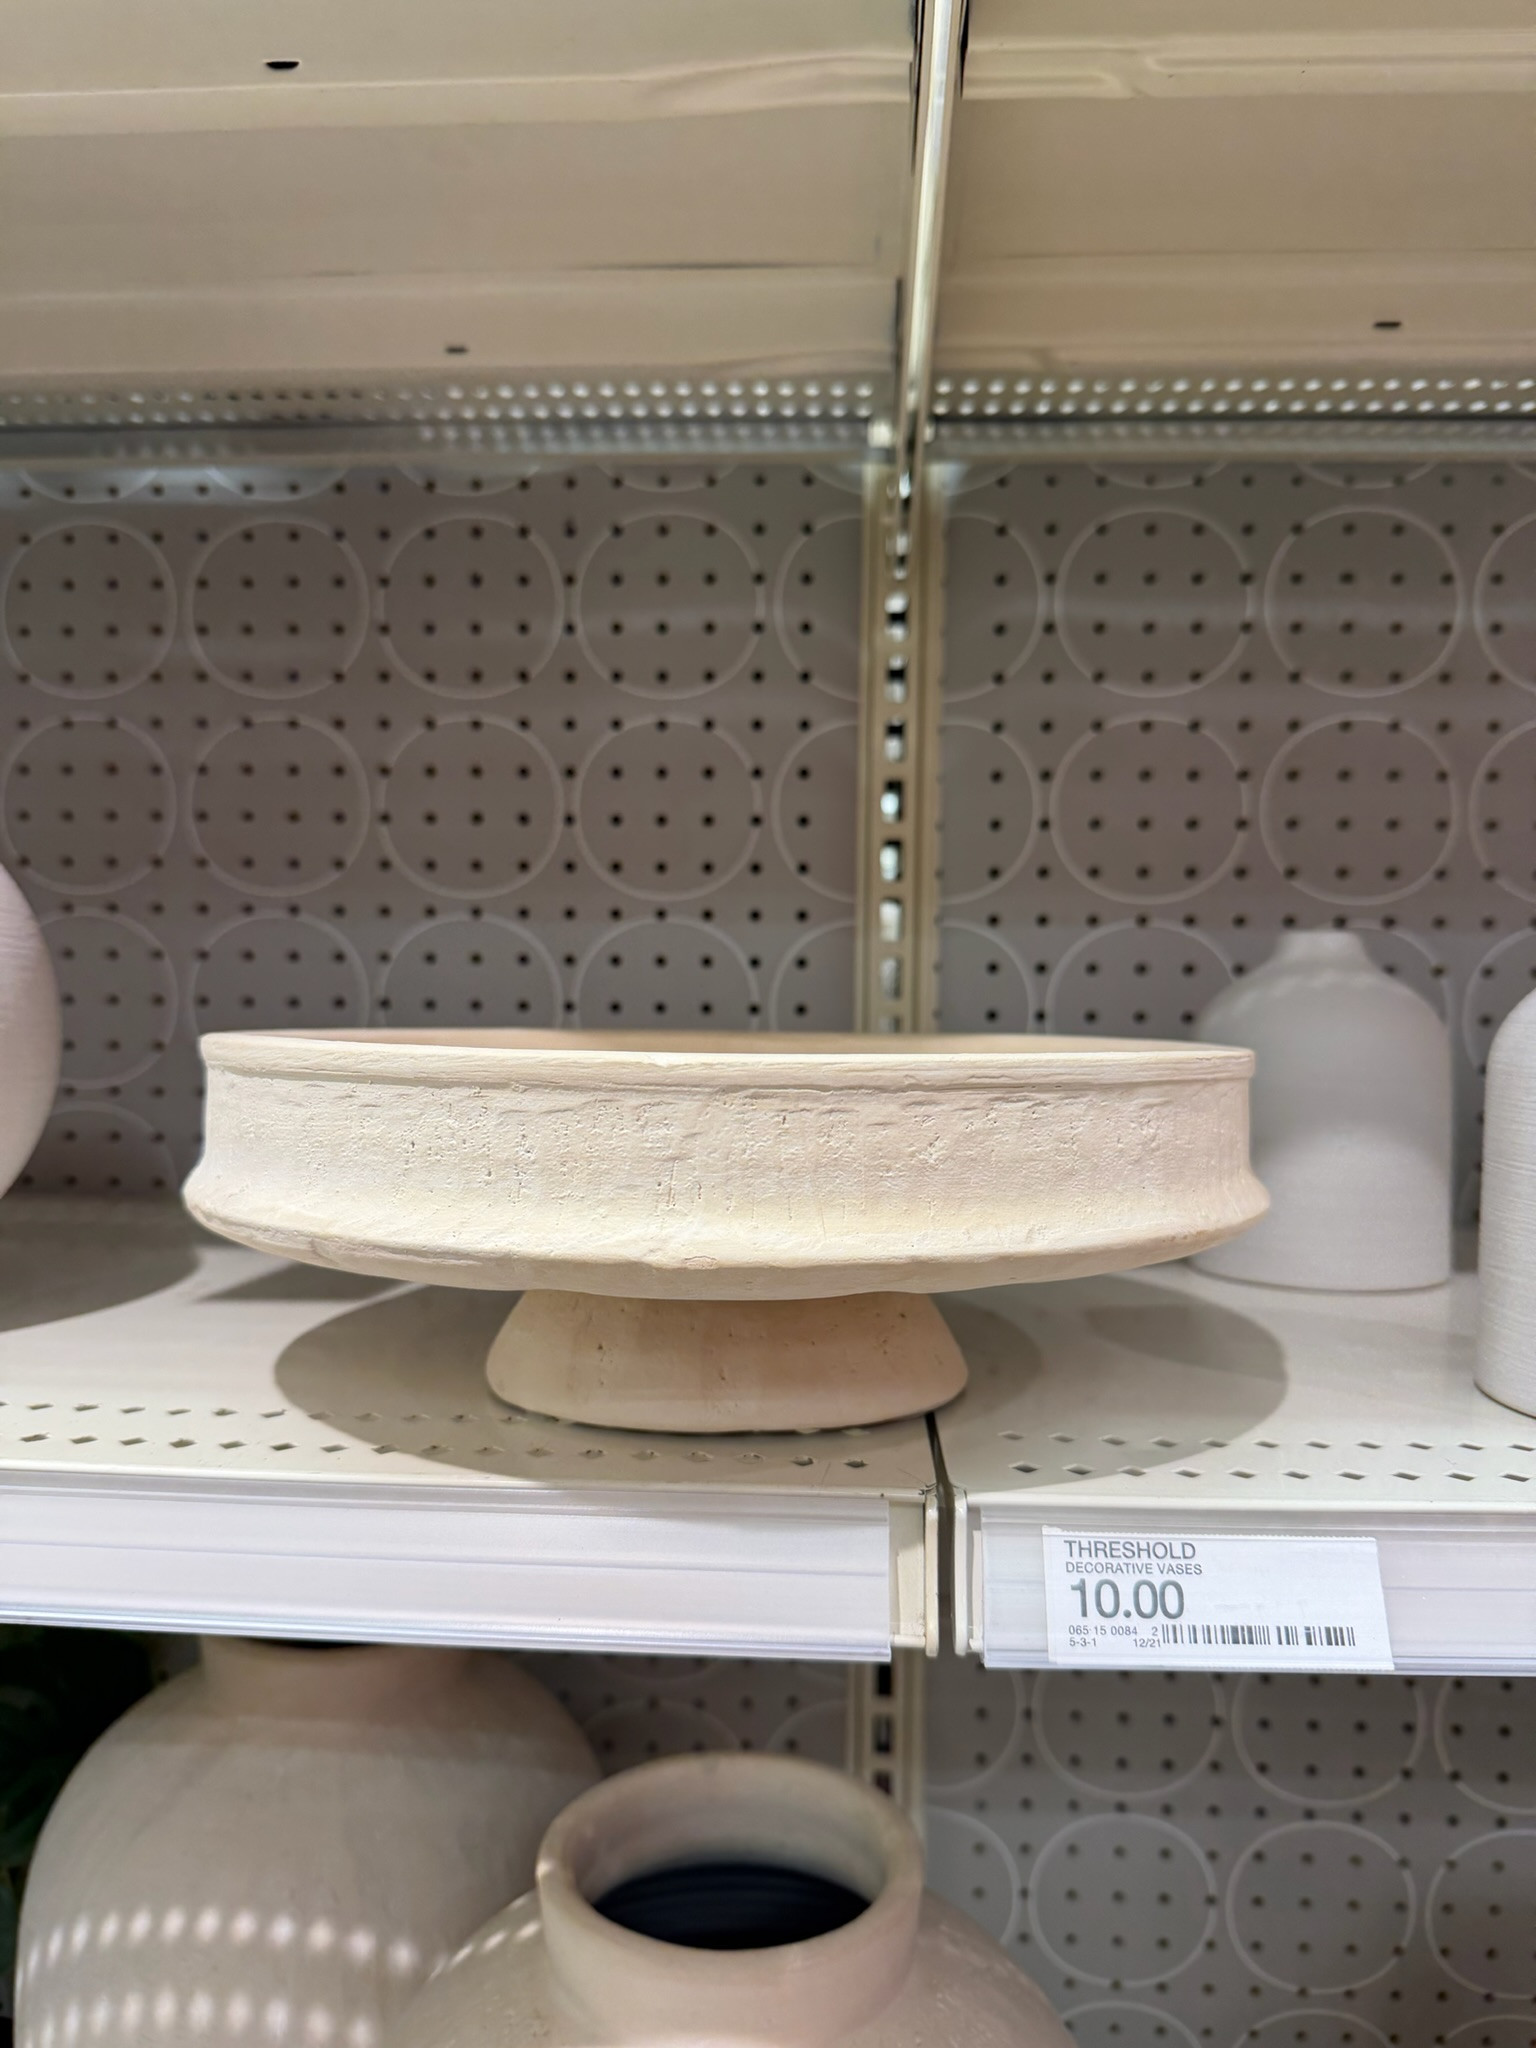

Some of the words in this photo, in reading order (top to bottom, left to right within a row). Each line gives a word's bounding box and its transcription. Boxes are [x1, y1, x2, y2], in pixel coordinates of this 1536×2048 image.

[1064, 1540, 1196, 1560] THRESHOLD
[1065, 1562, 1154, 1574] DECORATIVE
[1157, 1564, 1203, 1575] VASES
[1070, 1578, 1185, 1619] 10.00
[1110, 1625, 1138, 1636] 0084
[1151, 1626, 1159, 1637] 2
[1069, 1638, 1097, 1648] 5-3-1
[1132, 1638, 1161, 1649] 12/21
